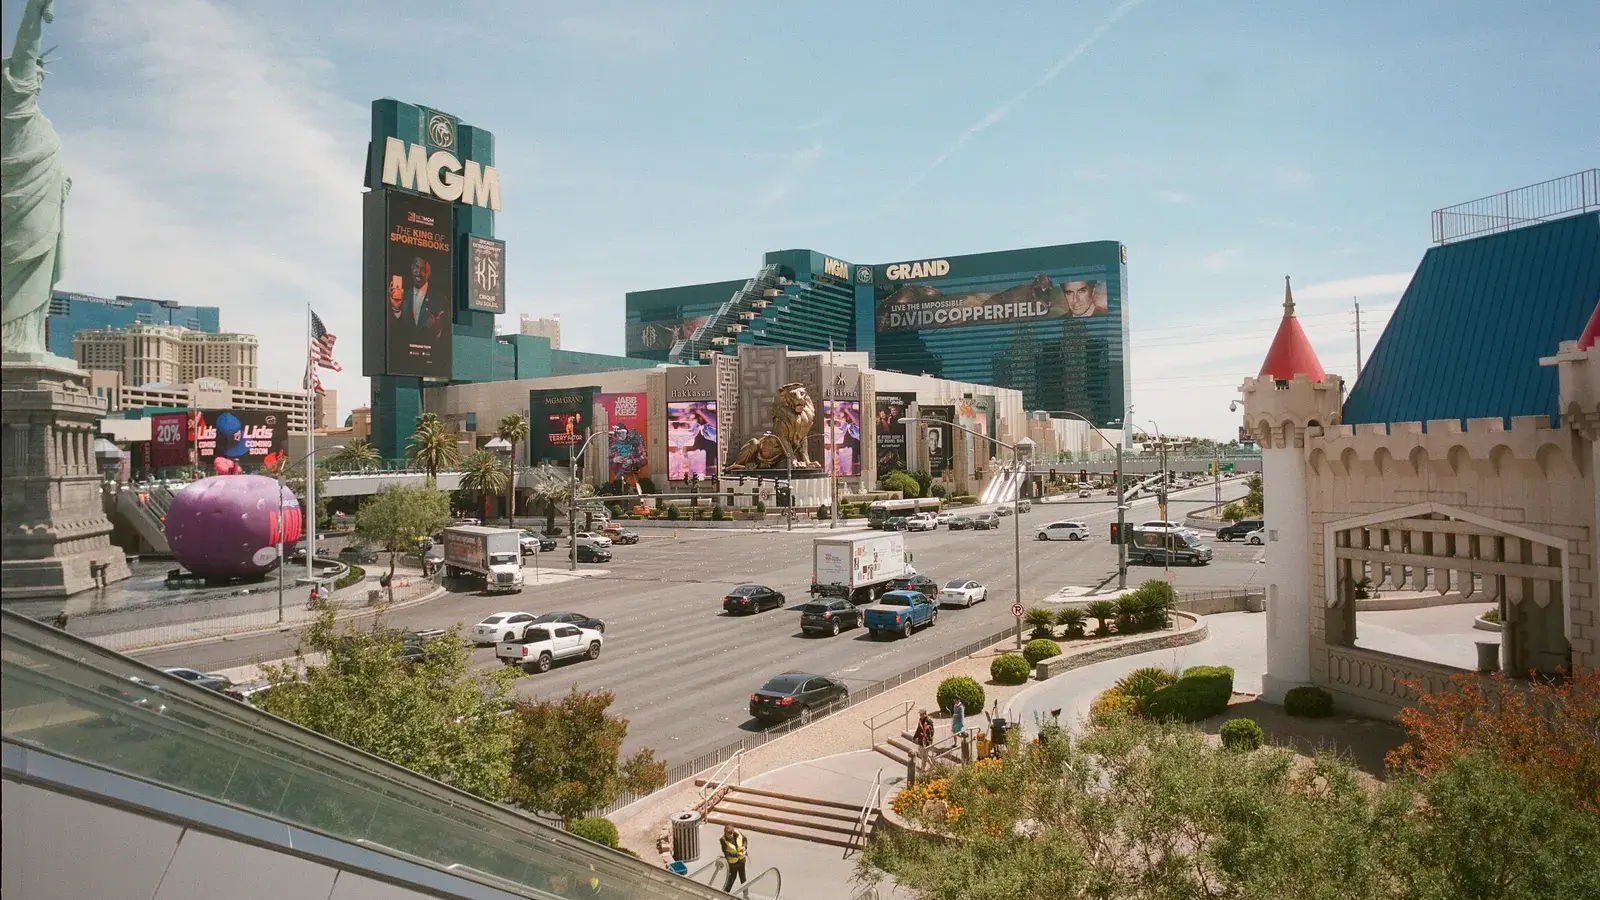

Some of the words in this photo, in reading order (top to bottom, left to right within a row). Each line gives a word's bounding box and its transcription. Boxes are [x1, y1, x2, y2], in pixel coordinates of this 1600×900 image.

[382, 136, 502, 212] MGM
[396, 225, 411, 235] THE
[412, 229, 434, 241] KING
[434, 233, 446, 242] OF
[390, 232, 450, 252] SPORTSBOOKS
[824, 257, 849, 280] MGM
[886, 259, 950, 281] GRAND
[907, 303, 920, 311] THE
[921, 299, 965, 310] IMPOSSIBLE
[545, 397, 563, 405] MGM
[563, 395, 584, 404] GRAND
[671, 389, 713, 398] Hakkasan
[157, 424, 181, 443] 20%
[243, 424, 274, 439] Lids
[549, 434, 567, 442] TERRY
[244, 440, 272, 448] COMING
[248, 447, 269, 455] SOON
